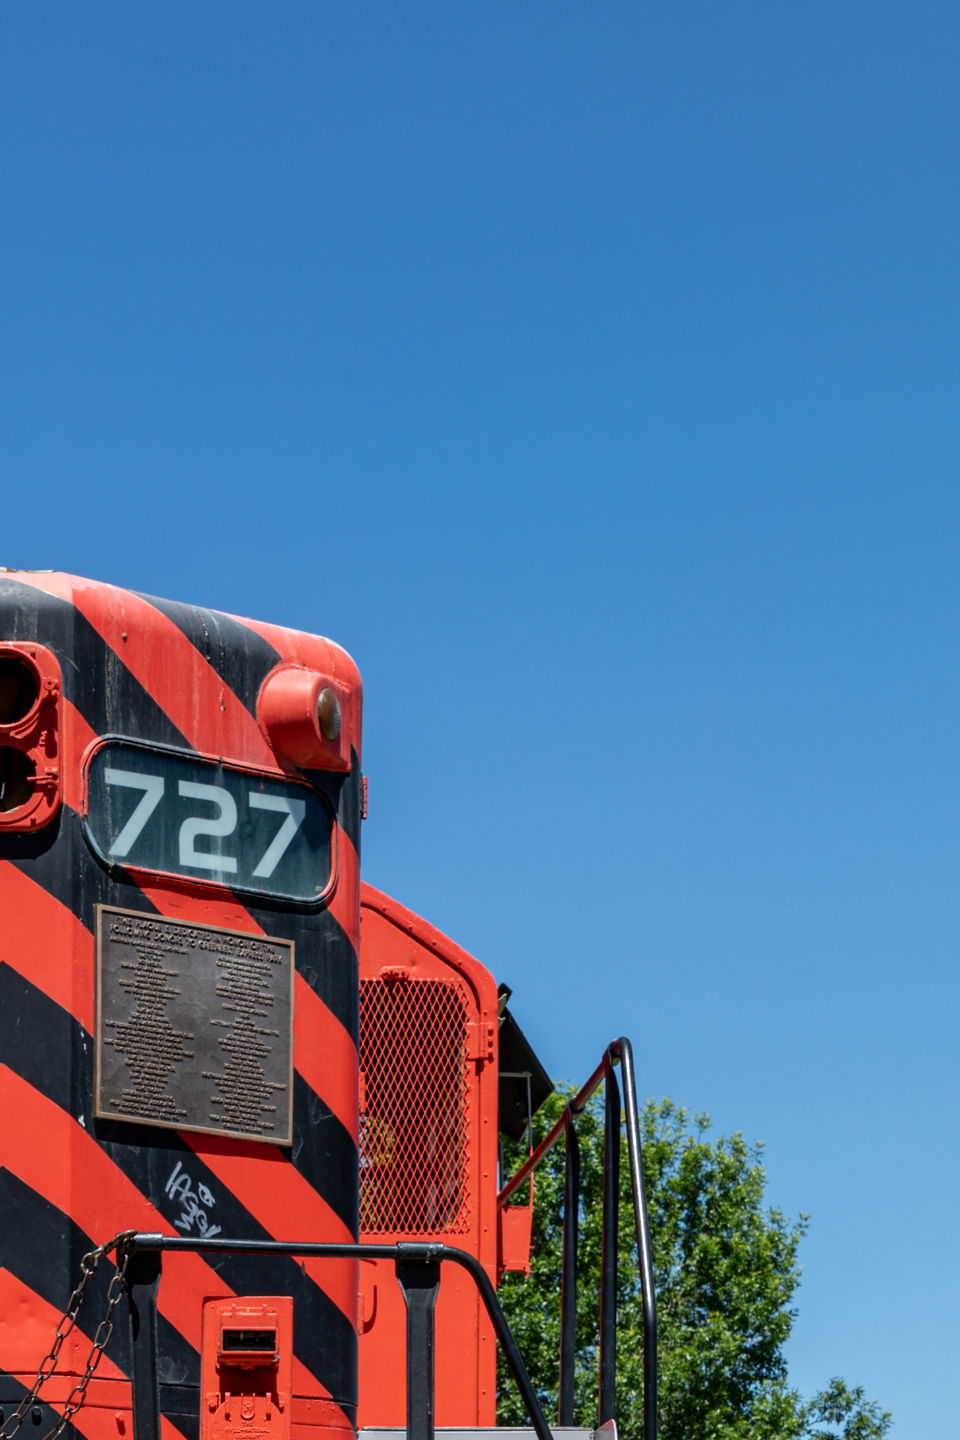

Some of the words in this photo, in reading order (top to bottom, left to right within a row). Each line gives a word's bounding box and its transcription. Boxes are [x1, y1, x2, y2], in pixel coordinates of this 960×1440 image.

[104, 768, 306, 879] 727
[110, 924, 150, 939] FOLLOWING
[154, 932, 183, 945] DONORS
[185, 938, 195, 947] TO
[173, 926, 210, 941] DEDICATED
[223, 936, 247, 948] HONOR
